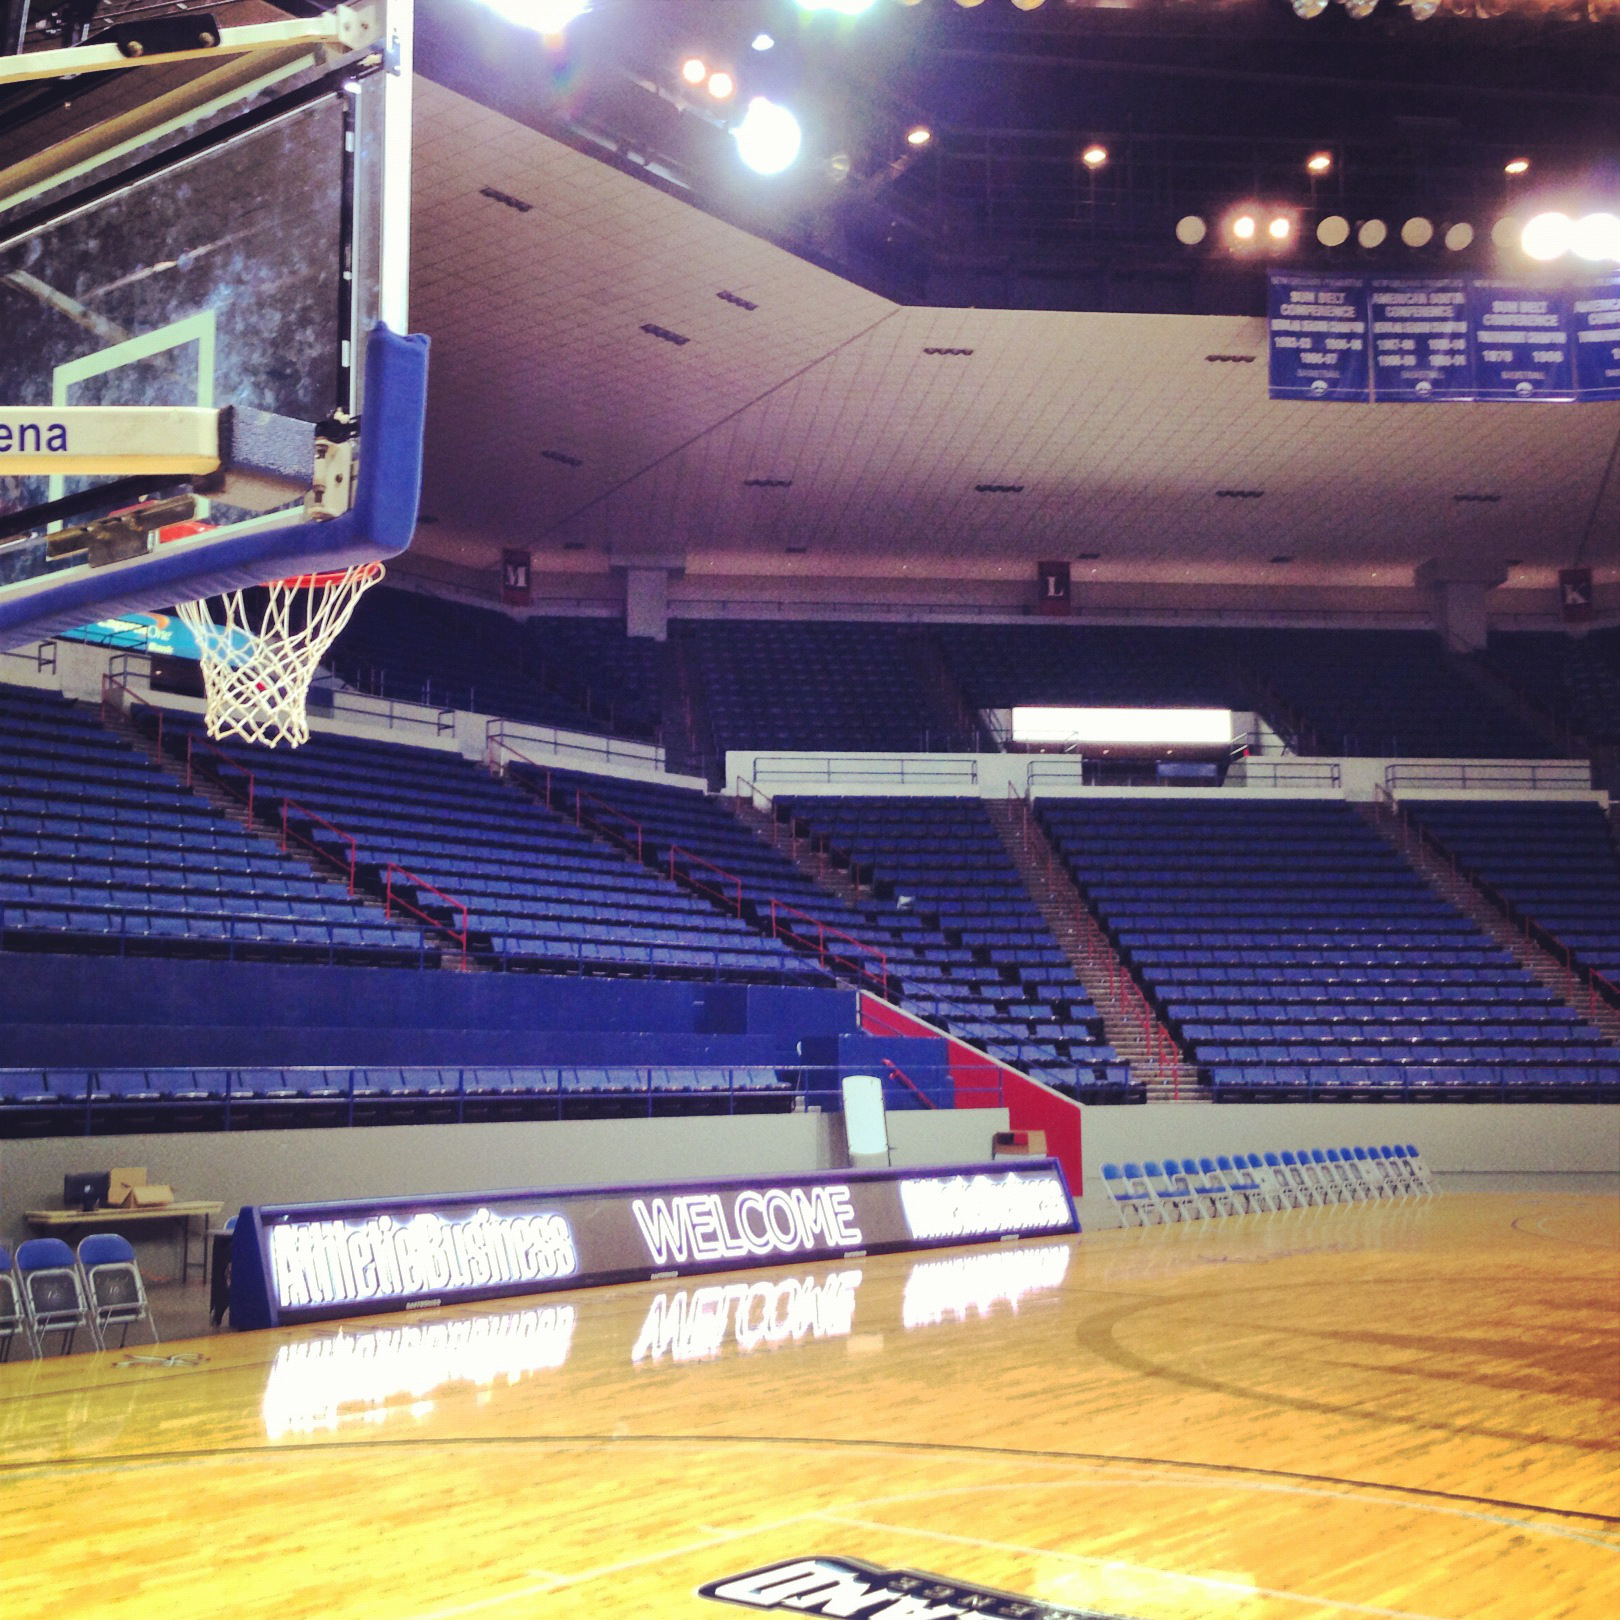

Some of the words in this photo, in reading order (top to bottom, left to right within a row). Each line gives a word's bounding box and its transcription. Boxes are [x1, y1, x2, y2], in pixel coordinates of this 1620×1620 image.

[1280, 304, 1356, 318] CONFERENCE
[1385, 305, 1455, 317] CONFERENCE
[1482, 314, 1559, 327] CONFERENCE
[0, 423, 68, 452] ena
[1046, 576, 1064, 596] L
[632, 1186, 862, 1265] WELCOME
